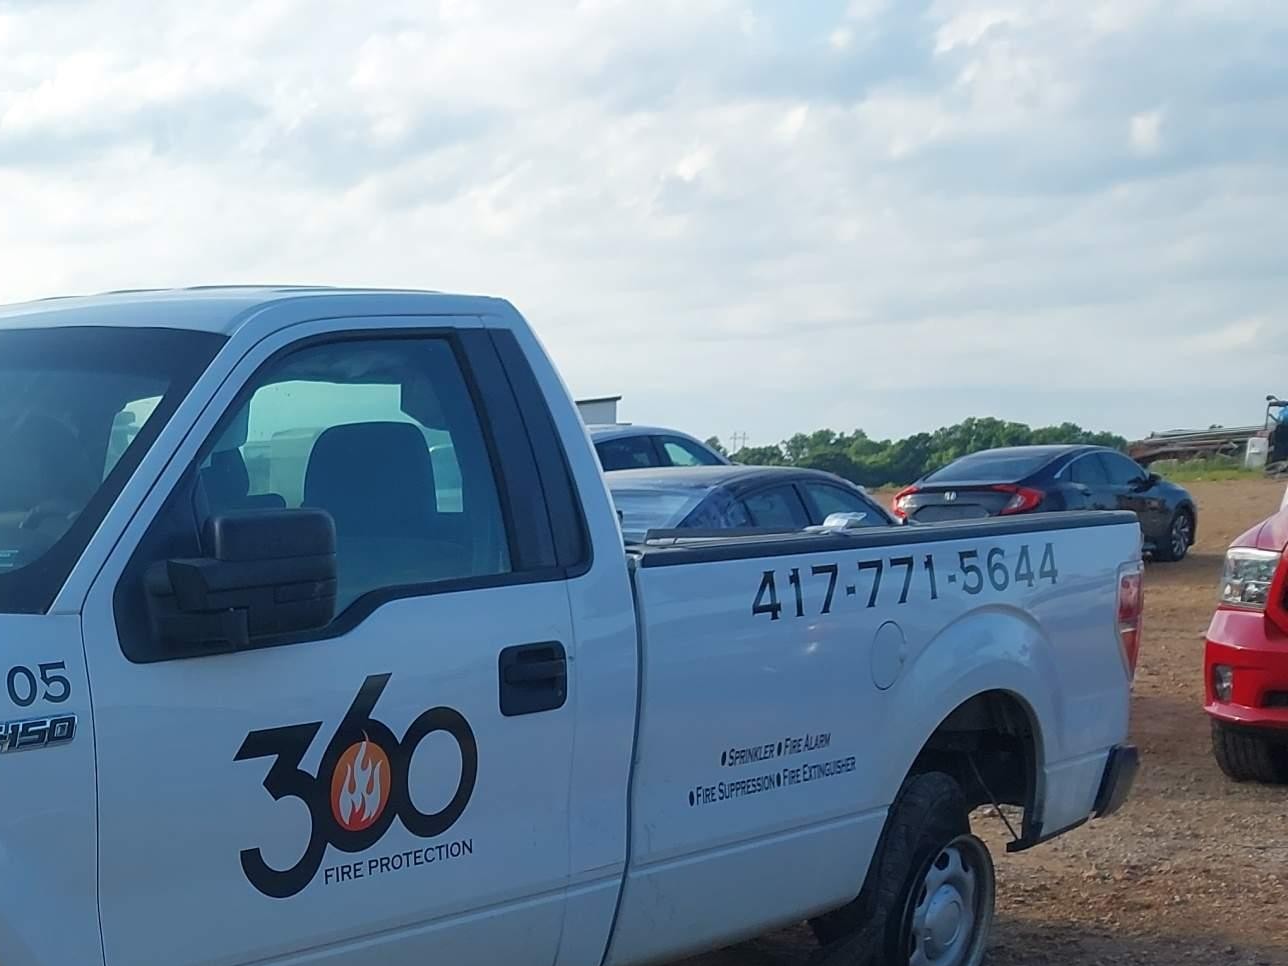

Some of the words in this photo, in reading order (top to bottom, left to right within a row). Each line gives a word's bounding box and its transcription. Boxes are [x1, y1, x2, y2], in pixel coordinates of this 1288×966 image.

[752, 542, 1058, 620] 417-771-5644
[6, 661, 71, 707] 05
[727, 743, 775, 767] SPRINKLER
[783, 736, 803, 756] FIRE
[803, 732, 831, 750] ALARM
[232, 672, 478, 899] 360
[696, 786, 717, 806] FIRE
[718, 773, 775, 801] SUPPRESSION
[783, 768, 801, 786] FIRE
[802, 756, 856, 782] EXTINGUISHER
[324, 862, 363, 885] FIRE
[368, 839, 473, 876] PROTECTION
